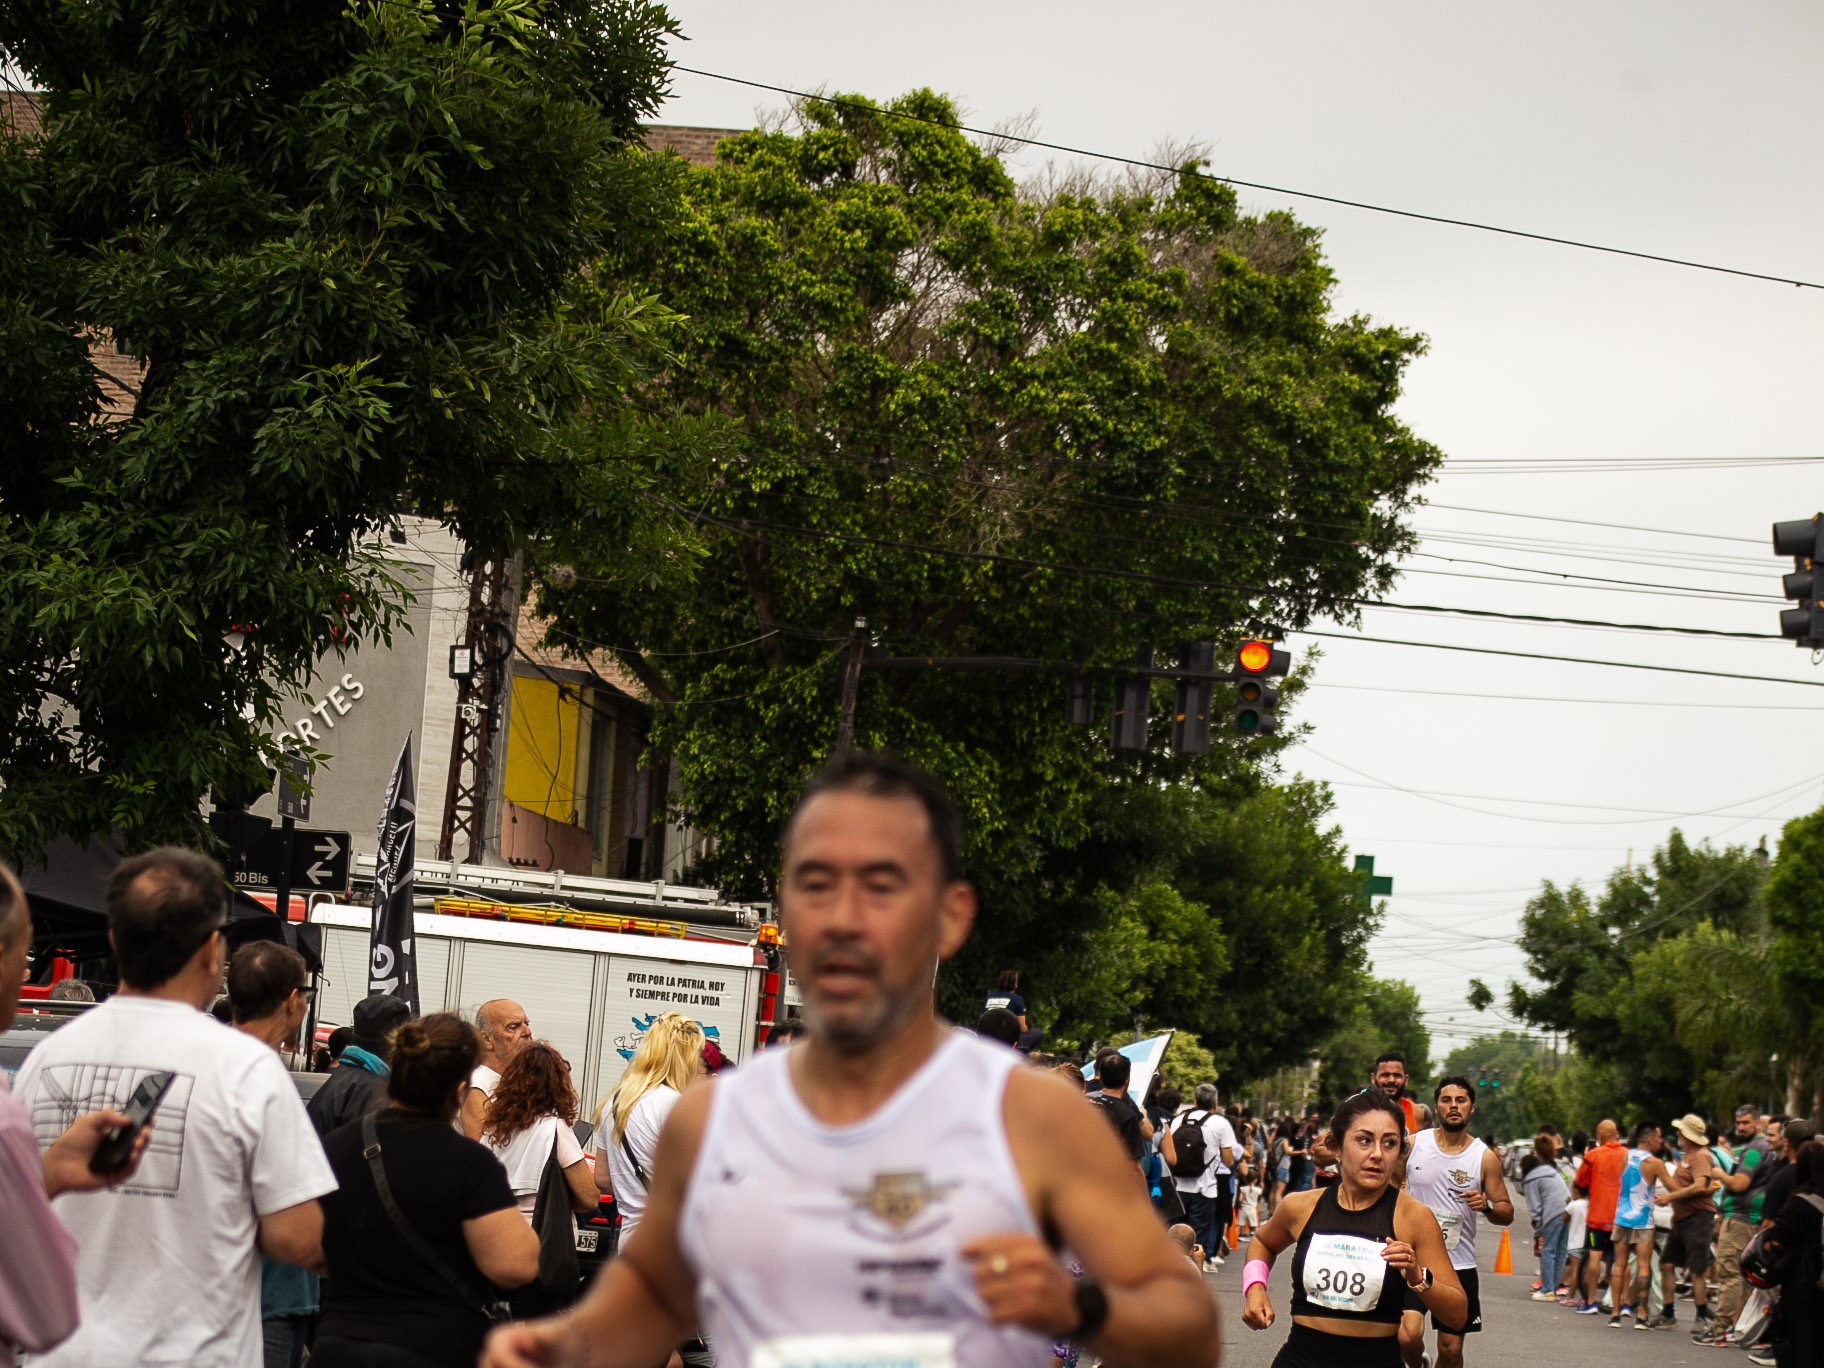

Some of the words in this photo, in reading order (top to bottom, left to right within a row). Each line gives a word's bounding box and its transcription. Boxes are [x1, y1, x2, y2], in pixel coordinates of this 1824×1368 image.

[262, 673, 365, 762] ORTES
[234, 871, 247, 883] 50
[248, 872, 269, 884] Bis
[369, 943, 399, 995] NG
[627, 972, 647, 984] AYER
[648, 974, 665, 986] POR
[666, 976, 676, 987] LA
[677, 978, 707, 991] PATRIA,
[708, 980, 726, 992] HOY
[629, 987, 635, 998] Y
[635, 988, 670, 1002] SIEMPRE
[671, 992, 688, 1003] POR
[689, 994, 699, 1005] LA
[701, 995, 721, 1007] VIDA
[580, 1235, 597, 1249] 575
[1441, 1228, 1449, 1241] 5
[1316, 1267, 1366, 1297] 308
